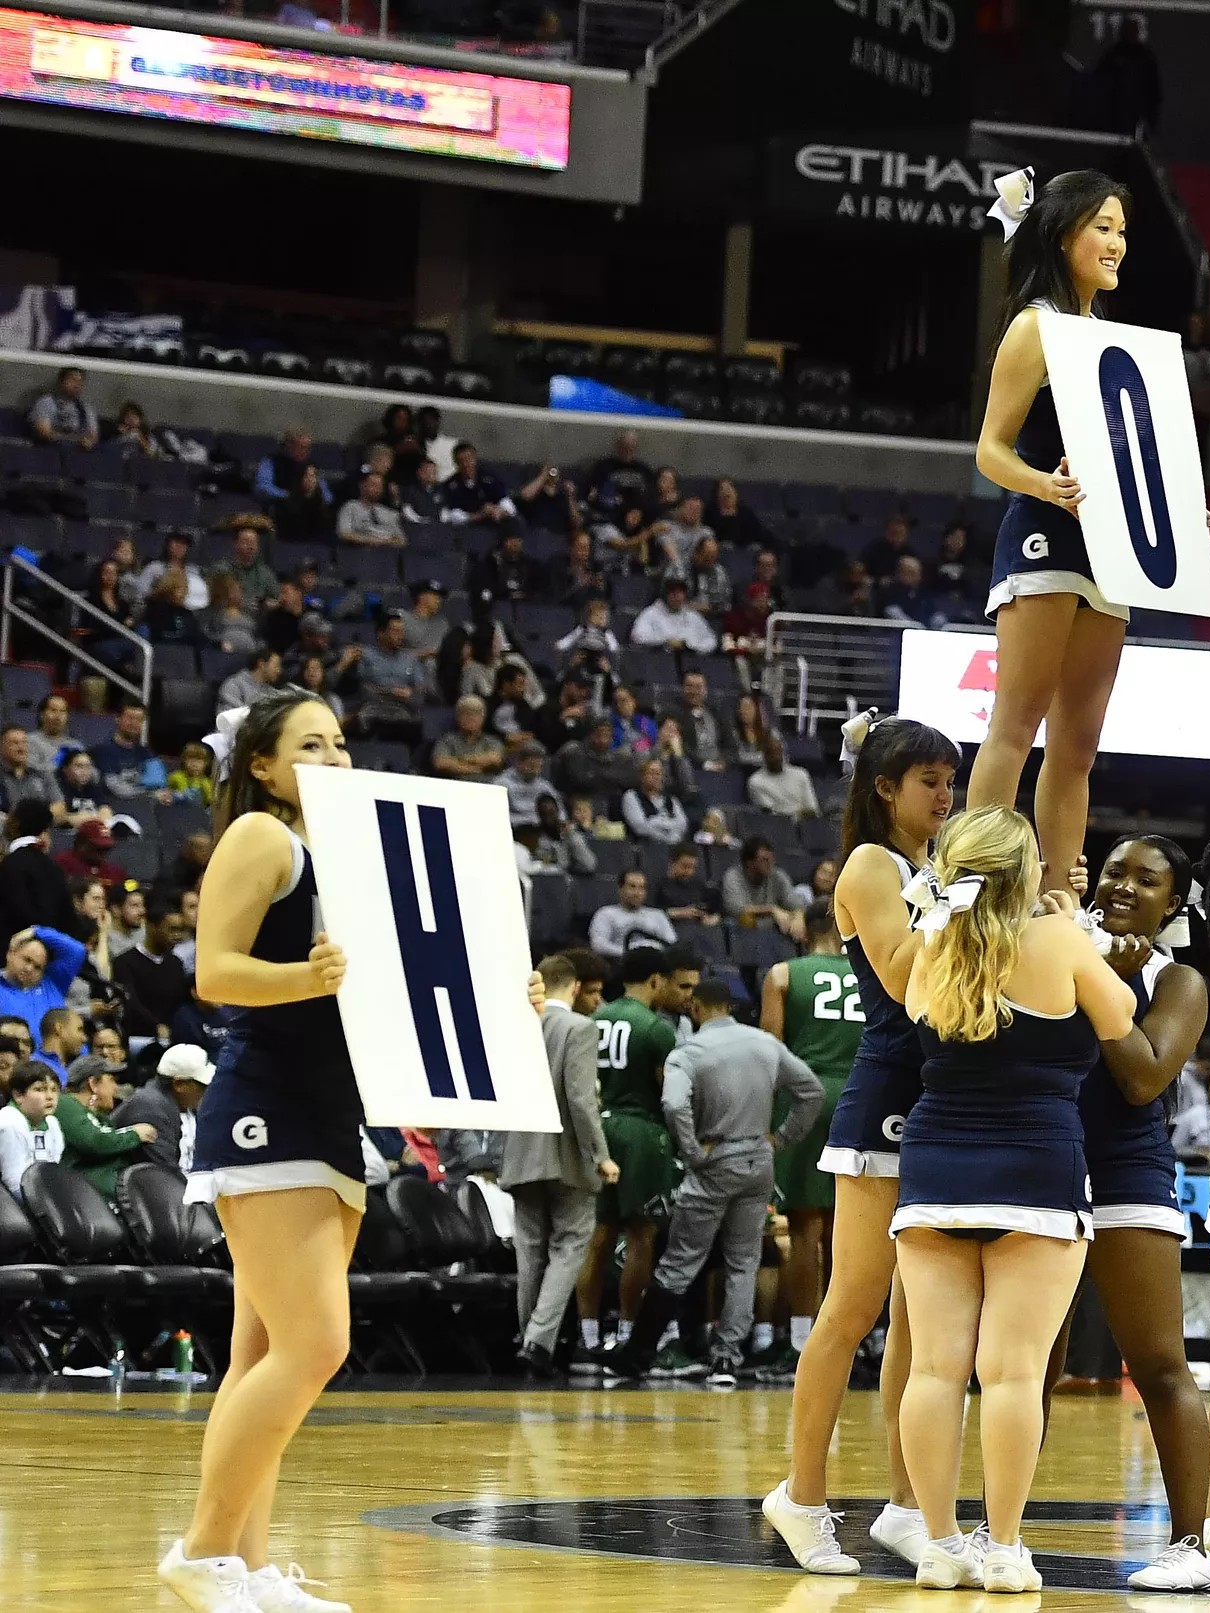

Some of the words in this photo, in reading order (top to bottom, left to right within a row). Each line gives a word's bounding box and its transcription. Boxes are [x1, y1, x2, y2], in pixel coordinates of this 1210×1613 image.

[837, 192, 987, 231] AIRWAYS
[1099, 346, 1177, 589] O
[1022, 532, 1049, 560] G
[375, 800, 496, 1102] H
[231, 1115, 268, 1149] G
